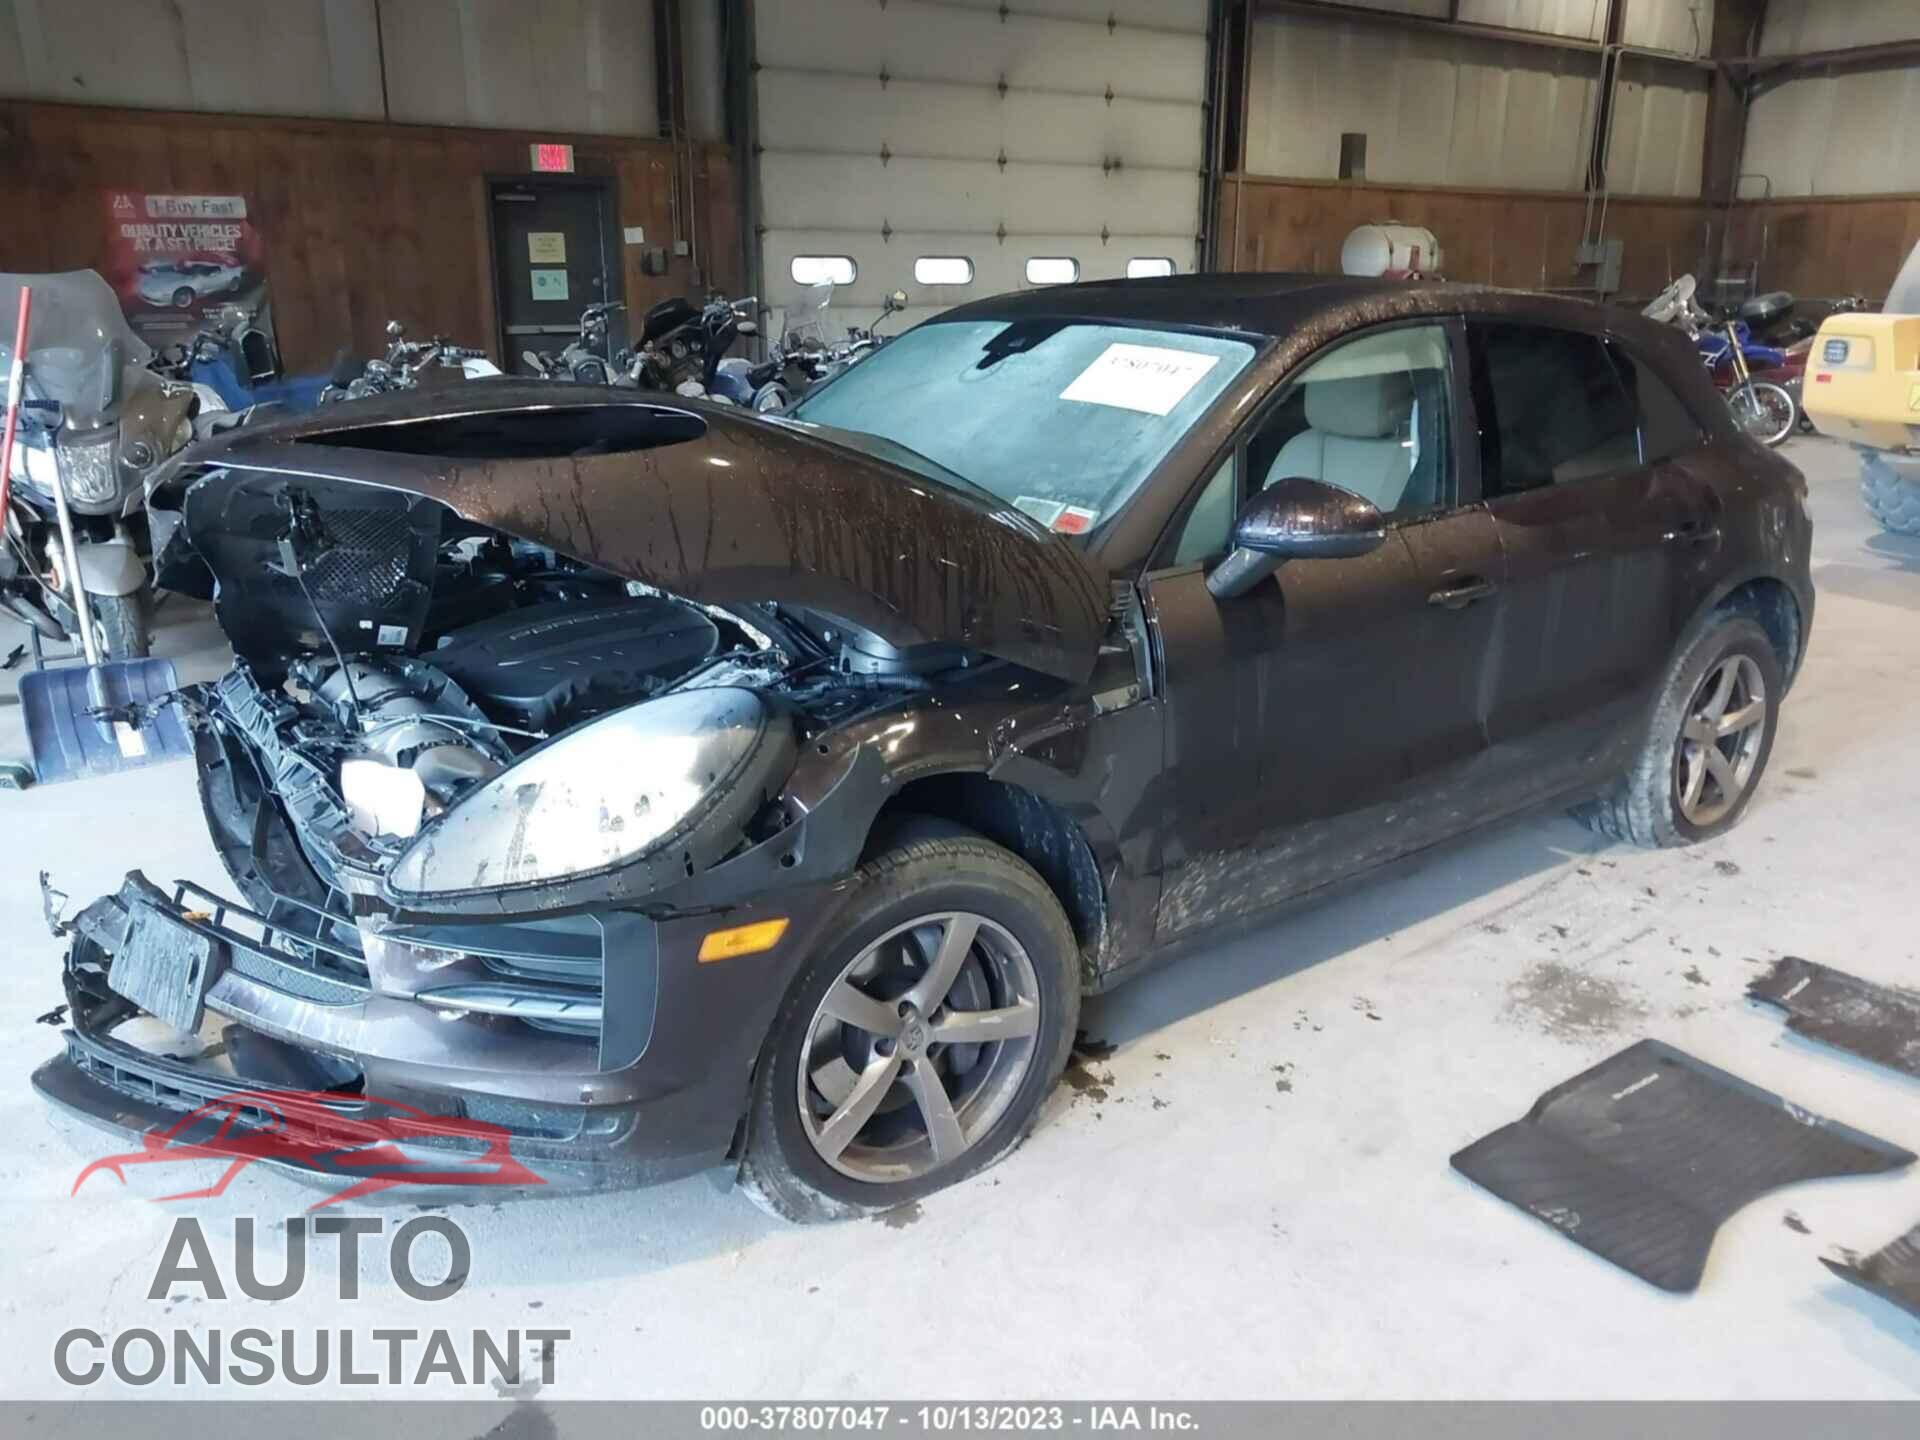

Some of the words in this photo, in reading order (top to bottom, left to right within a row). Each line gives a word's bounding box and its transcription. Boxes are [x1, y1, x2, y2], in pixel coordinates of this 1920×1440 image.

[202, 199, 233, 213] Fast
[120, 224, 177, 238] QUALITY
[176, 224, 242, 238] VEHICLES
[133, 237, 153, 251] AT
[154, 237, 165, 251] A
